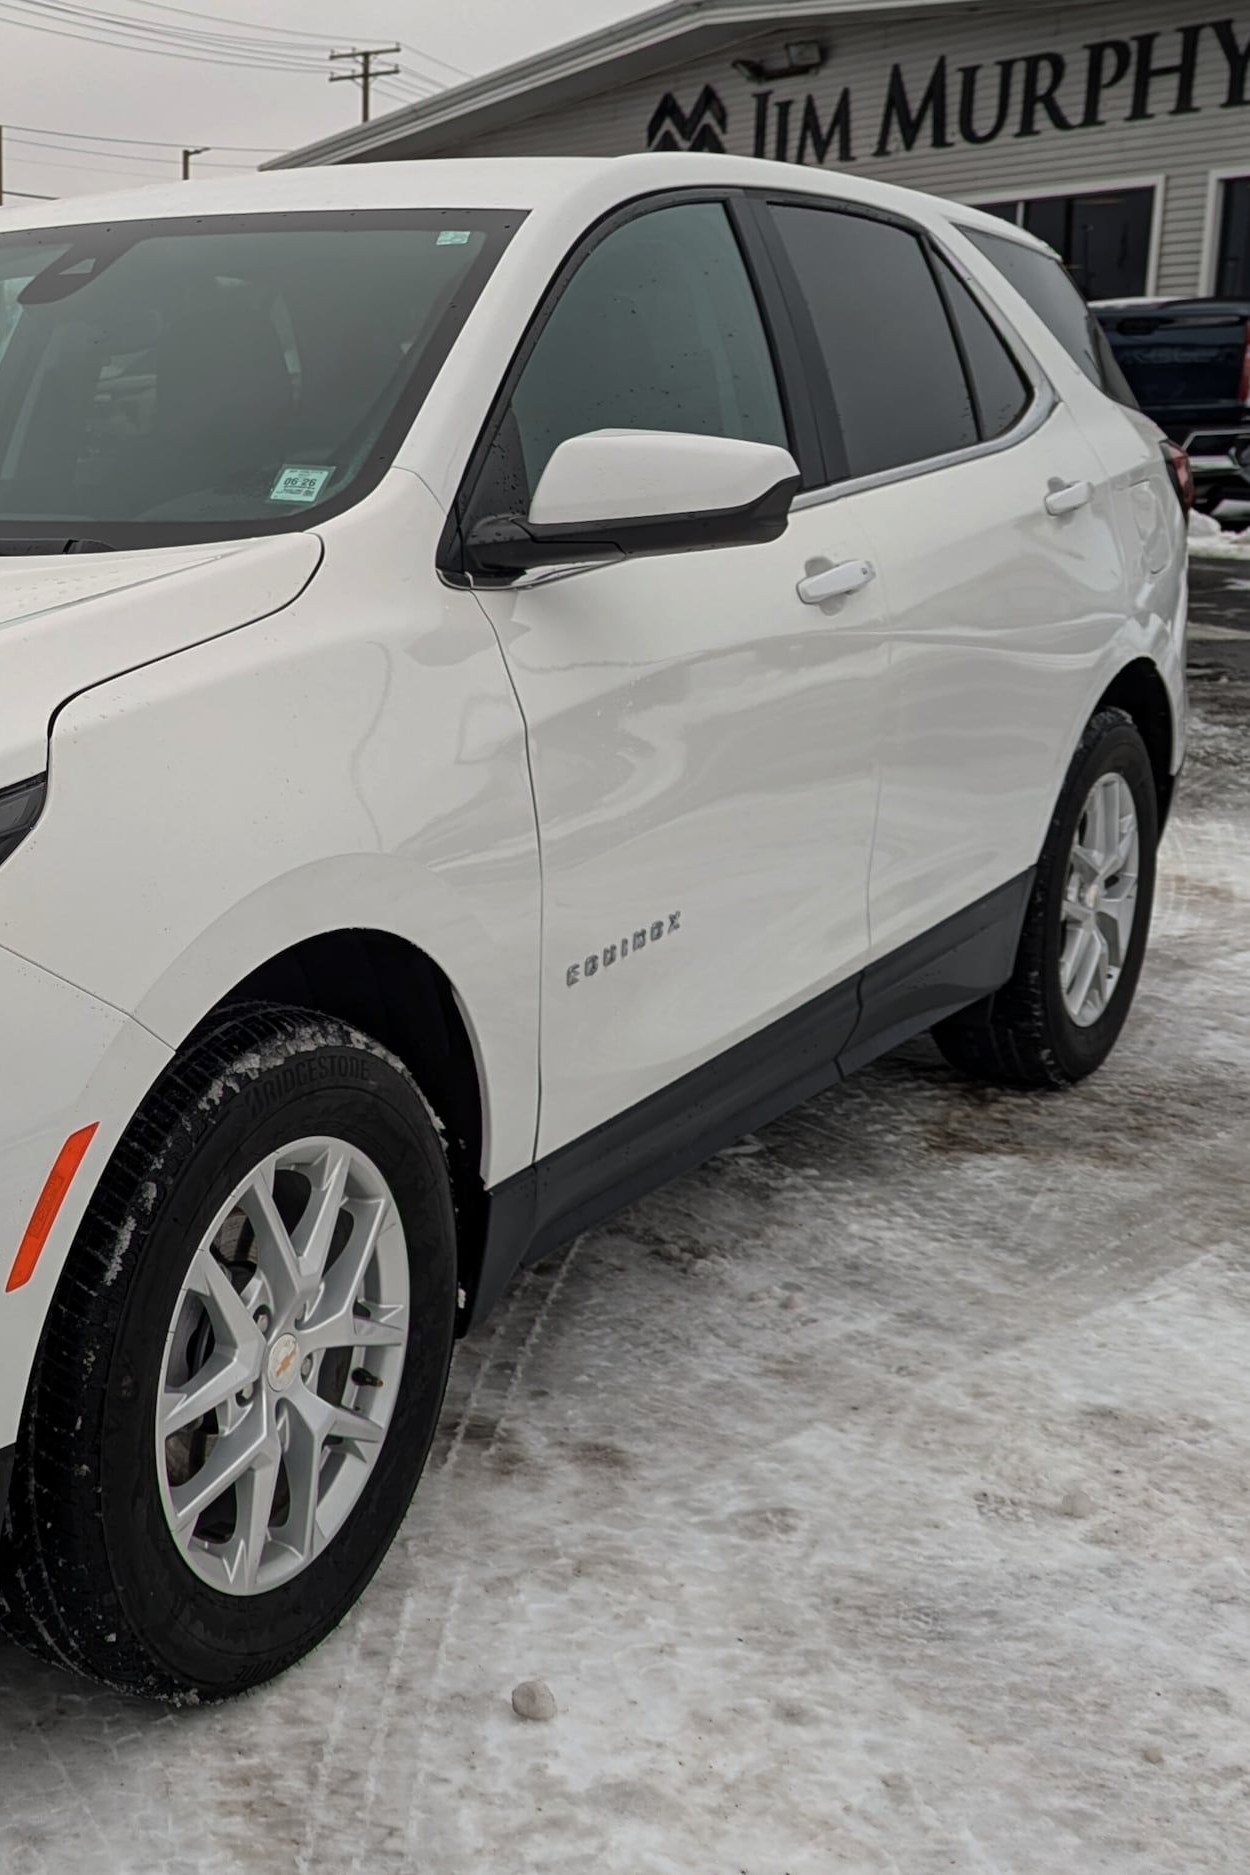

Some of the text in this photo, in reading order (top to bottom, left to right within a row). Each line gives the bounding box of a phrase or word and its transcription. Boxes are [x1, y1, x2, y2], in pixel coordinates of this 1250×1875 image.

[871, 18, 1250, 157] MURPHY
[565, 910, 681, 988] EQUINOX
[244, 1054, 370, 1117] BRIDGESTONE
